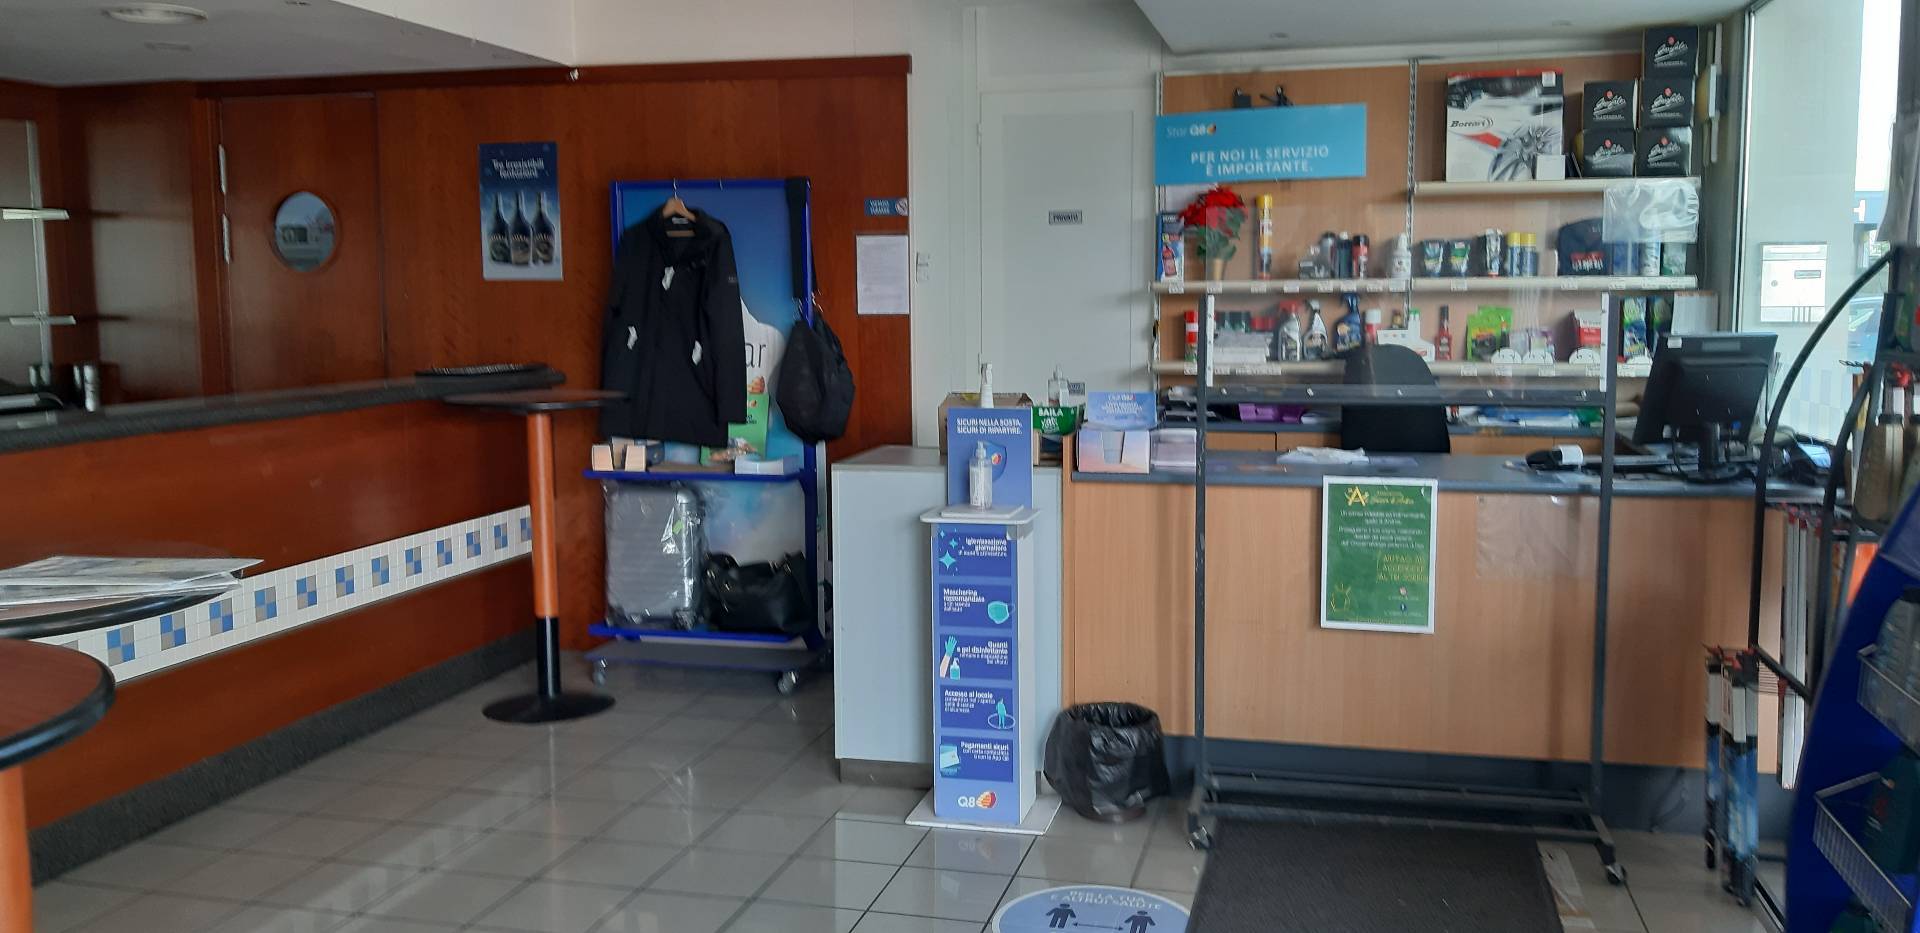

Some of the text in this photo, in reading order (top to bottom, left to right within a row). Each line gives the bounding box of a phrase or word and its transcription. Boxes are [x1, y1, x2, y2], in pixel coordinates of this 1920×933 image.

[1190, 124, 1206, 136] Q8
[1191, 145, 1329, 164] PER NOI IL SERVIZIO
[1206, 158, 1313, 177] È IMPORTANTE.
[1038, 408, 1064, 417] BAILA
[957, 418, 1023, 428] SICURI NELLA SOSTA,
[957, 426, 1023, 435] SICURI DI RIPARTIRE.
[944, 689, 968, 698] Accesso
[976, 690, 993, 698] locale
[961, 741, 992, 750] Pagamenti
[958, 796, 976, 807] Q8
